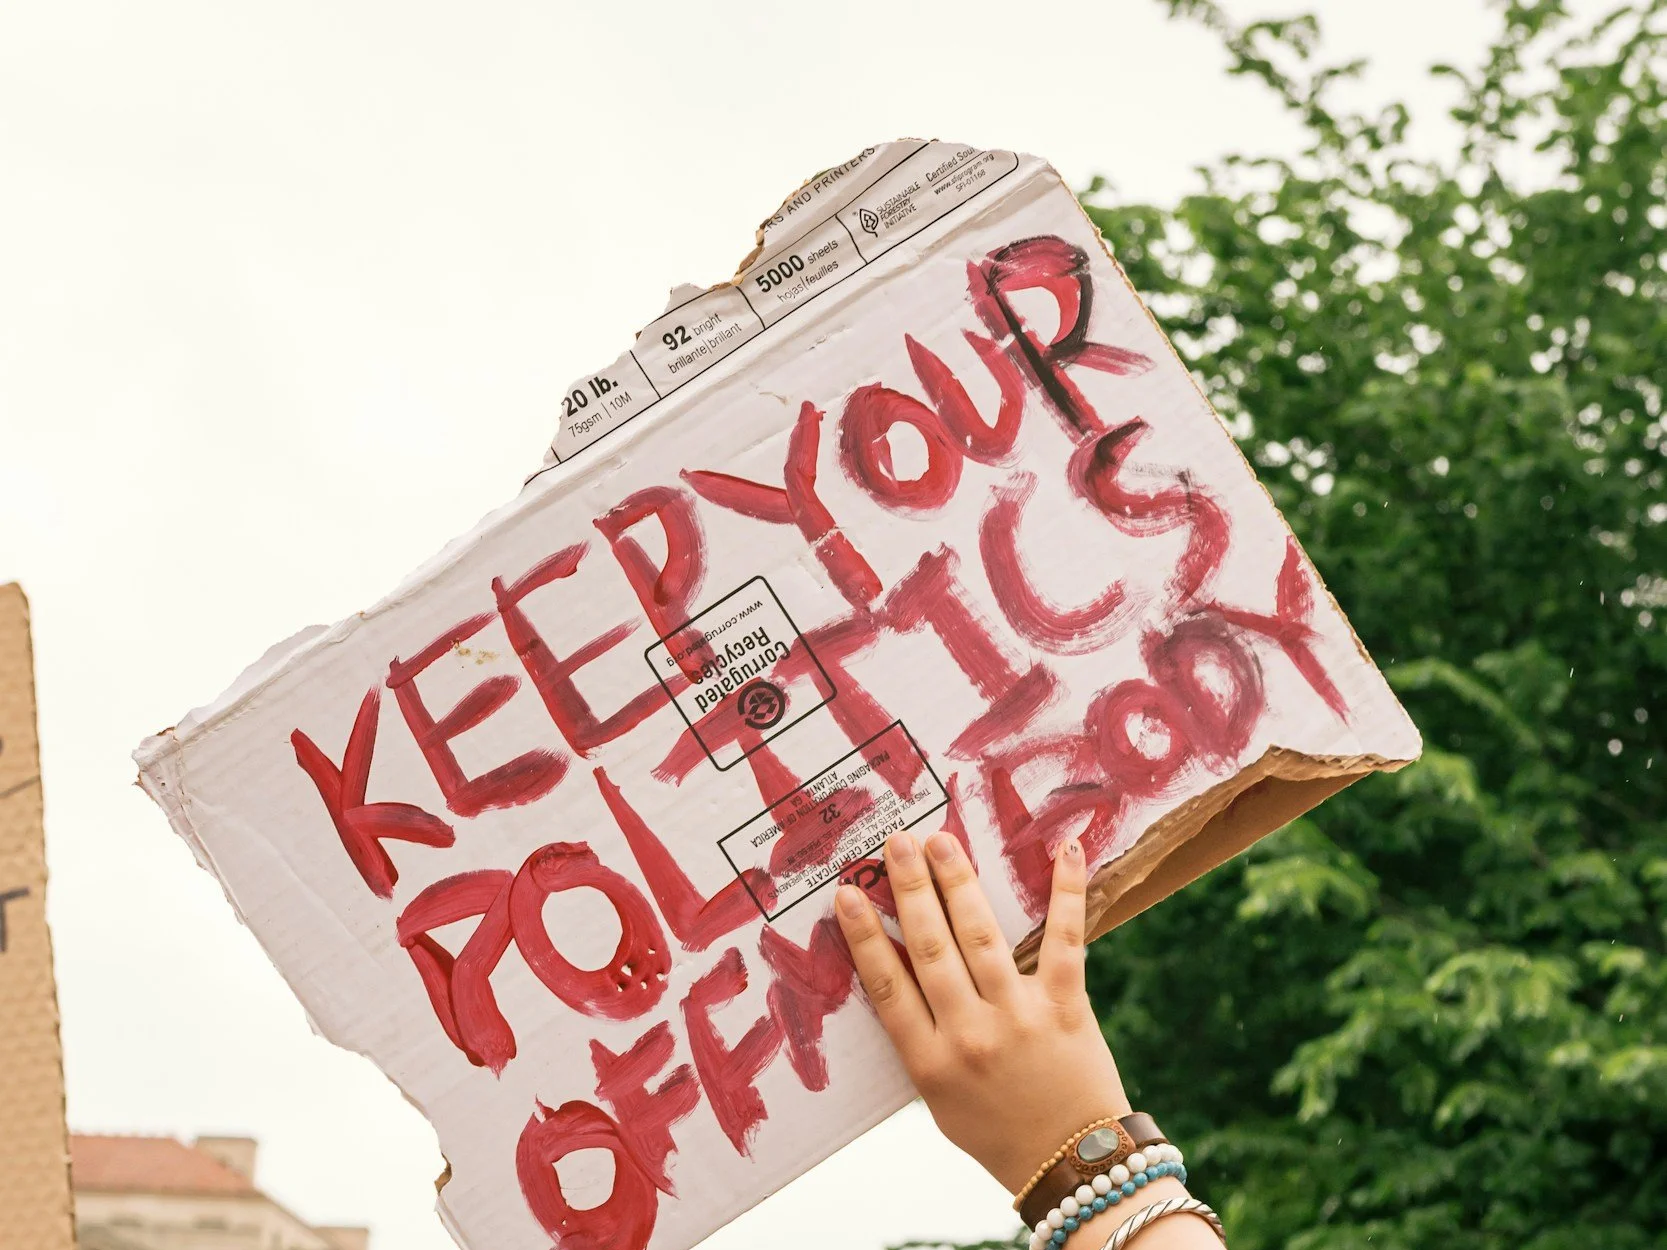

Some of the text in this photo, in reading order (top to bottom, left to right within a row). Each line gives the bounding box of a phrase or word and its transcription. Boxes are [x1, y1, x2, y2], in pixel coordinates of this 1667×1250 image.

[785, 192, 812, 213] AND
[812, 147, 876, 191] PRINTERS
[925, 157, 957, 181] Certified
[875, 181, 920, 214] SUSTAINABLE
[879, 197, 911, 220] FORESTRY
[883, 203, 916, 228] INITIATIVE
[755, 238, 838, 292] 5000 sheets
[662, 313, 721, 350] 92 bright
[560, 370, 617, 415] 20 lb.
[568, 391, 631, 438] 75gsm 10M
[290, 235, 1156, 902] KEEP YOUR
[665, 600, 764, 667] www.corrugated.org
[688, 625, 769, 687] Recycles
[693, 640, 790, 711] Corrugated
[980, 535, 1351, 924] BODY
[396, 416, 1231, 1080] POLITICS
[750, 750, 889, 847] PACKAGING CORPORATION OF AMERICA
[790, 795, 802, 807] GA
[874, 790, 893, 805] EDGE
[900, 798, 915, 810] BOX
[914, 787, 930, 801] THIS
[819, 803, 840, 823] 32
[859, 799, 896, 827] APPLICABLE
[866, 822, 878, 834] ALL
[878, 807, 901, 825] MEETS
[832, 824, 859, 845] FREIGHT
[862, 817, 904, 849] PACKAGE
[766, 863, 817, 901] REQUIREMENTS
[805, 848, 858, 888] CERTIFICATE
